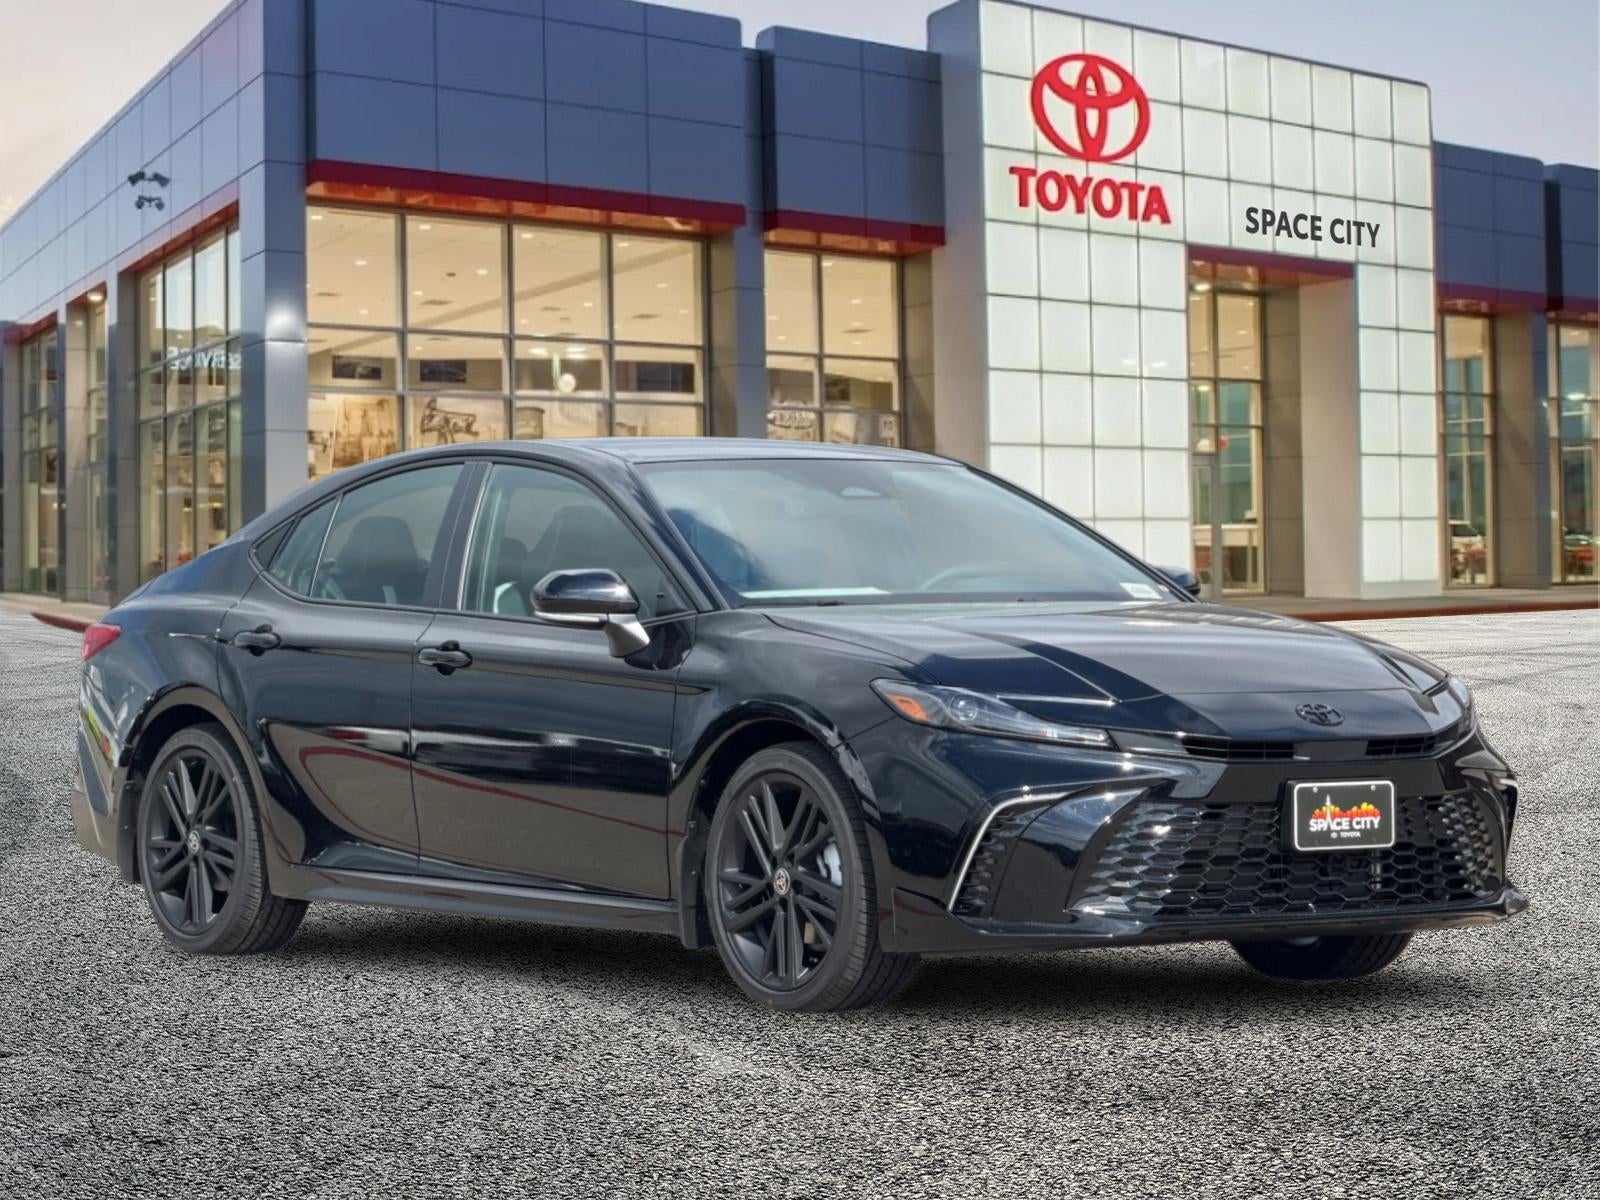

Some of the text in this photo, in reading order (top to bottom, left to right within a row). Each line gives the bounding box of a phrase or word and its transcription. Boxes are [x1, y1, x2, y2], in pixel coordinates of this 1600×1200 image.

[1009, 166, 1171, 225] TOYOTA
[1245, 206, 1381, 248] SPACE CITY
[1309, 816, 1380, 832] SPACE CITY
